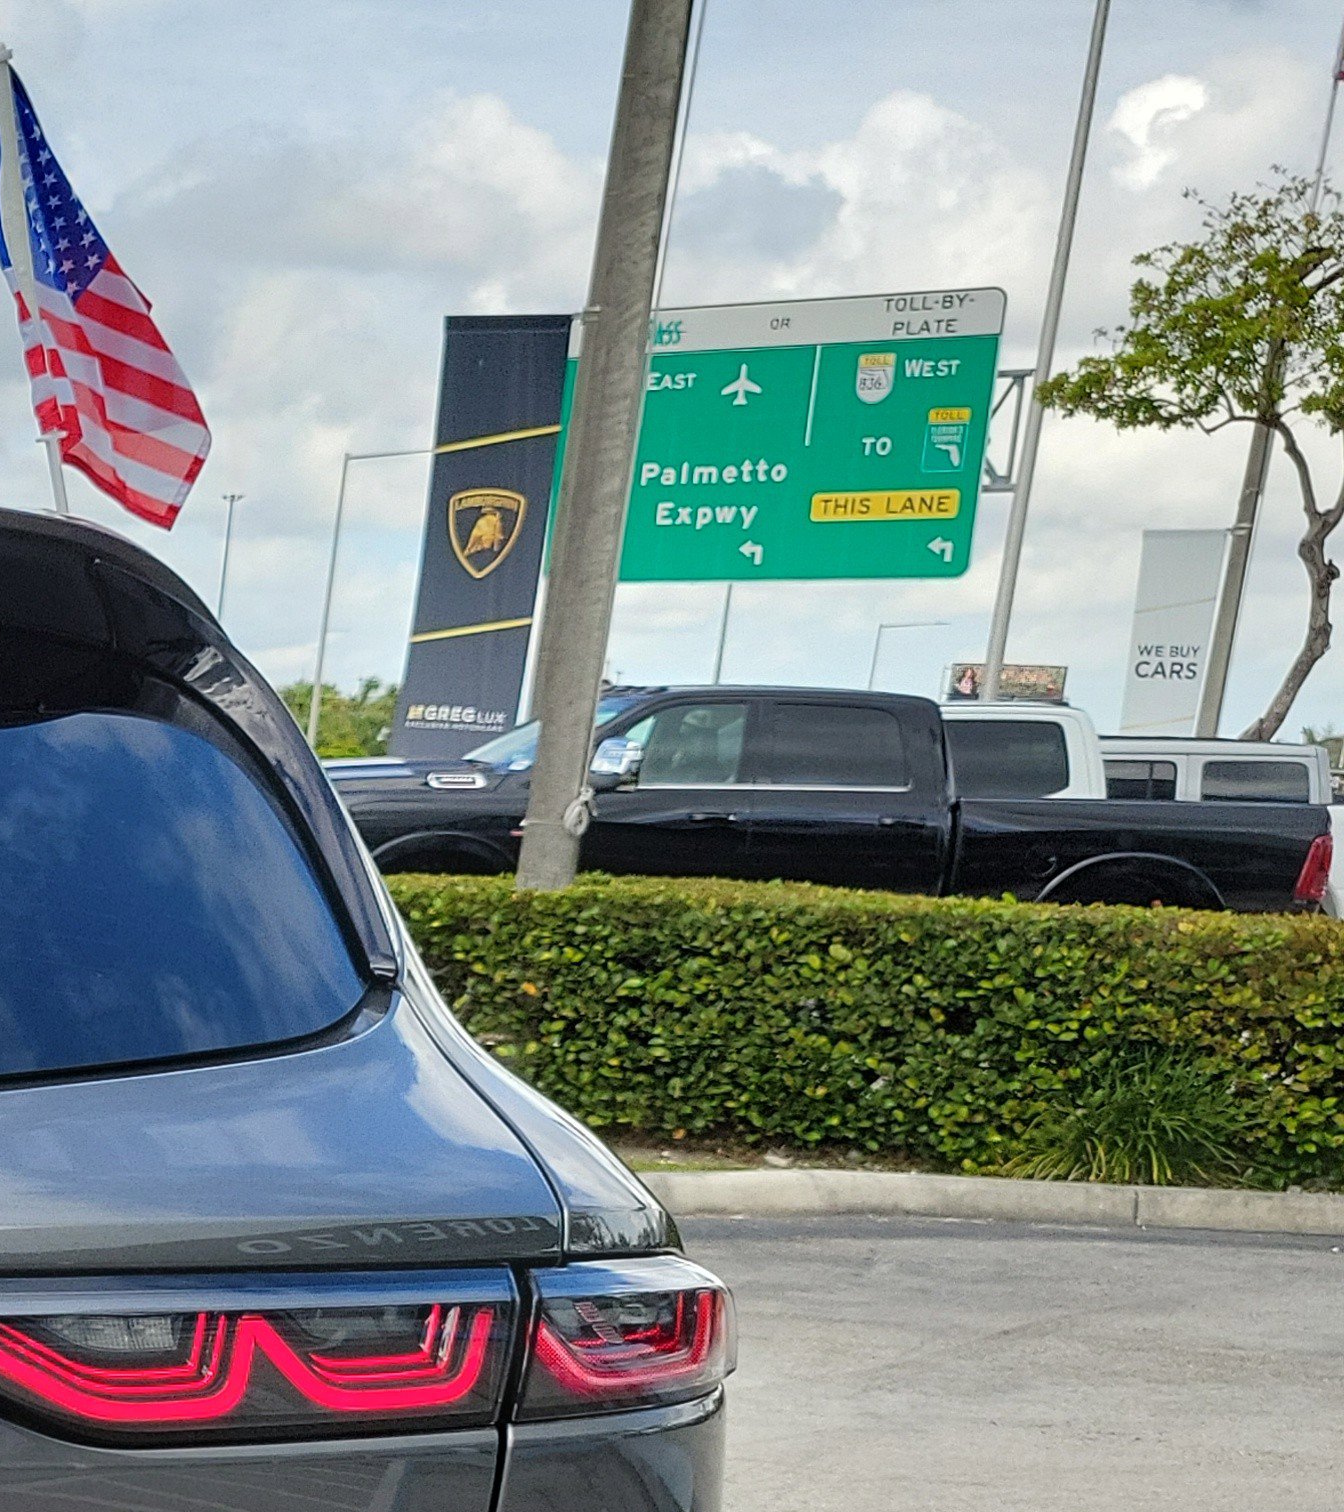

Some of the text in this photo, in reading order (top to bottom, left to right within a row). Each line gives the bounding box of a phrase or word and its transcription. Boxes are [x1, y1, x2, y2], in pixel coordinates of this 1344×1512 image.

[769, 317, 792, 330] OR
[891, 318, 959, 336] PLATE
[904, 358, 962, 378] WEST
[646, 372, 698, 391] EAST
[935, 409, 965, 421] TOLL
[861, 436, 893, 456] TO
[640, 458, 789, 487] Palmetto
[820, 495, 952, 517] THIS LANE
[655, 502, 759, 530] Expwy
[1137, 645, 1202, 658] WE BUY
[1134, 661, 1199, 680] CARS
